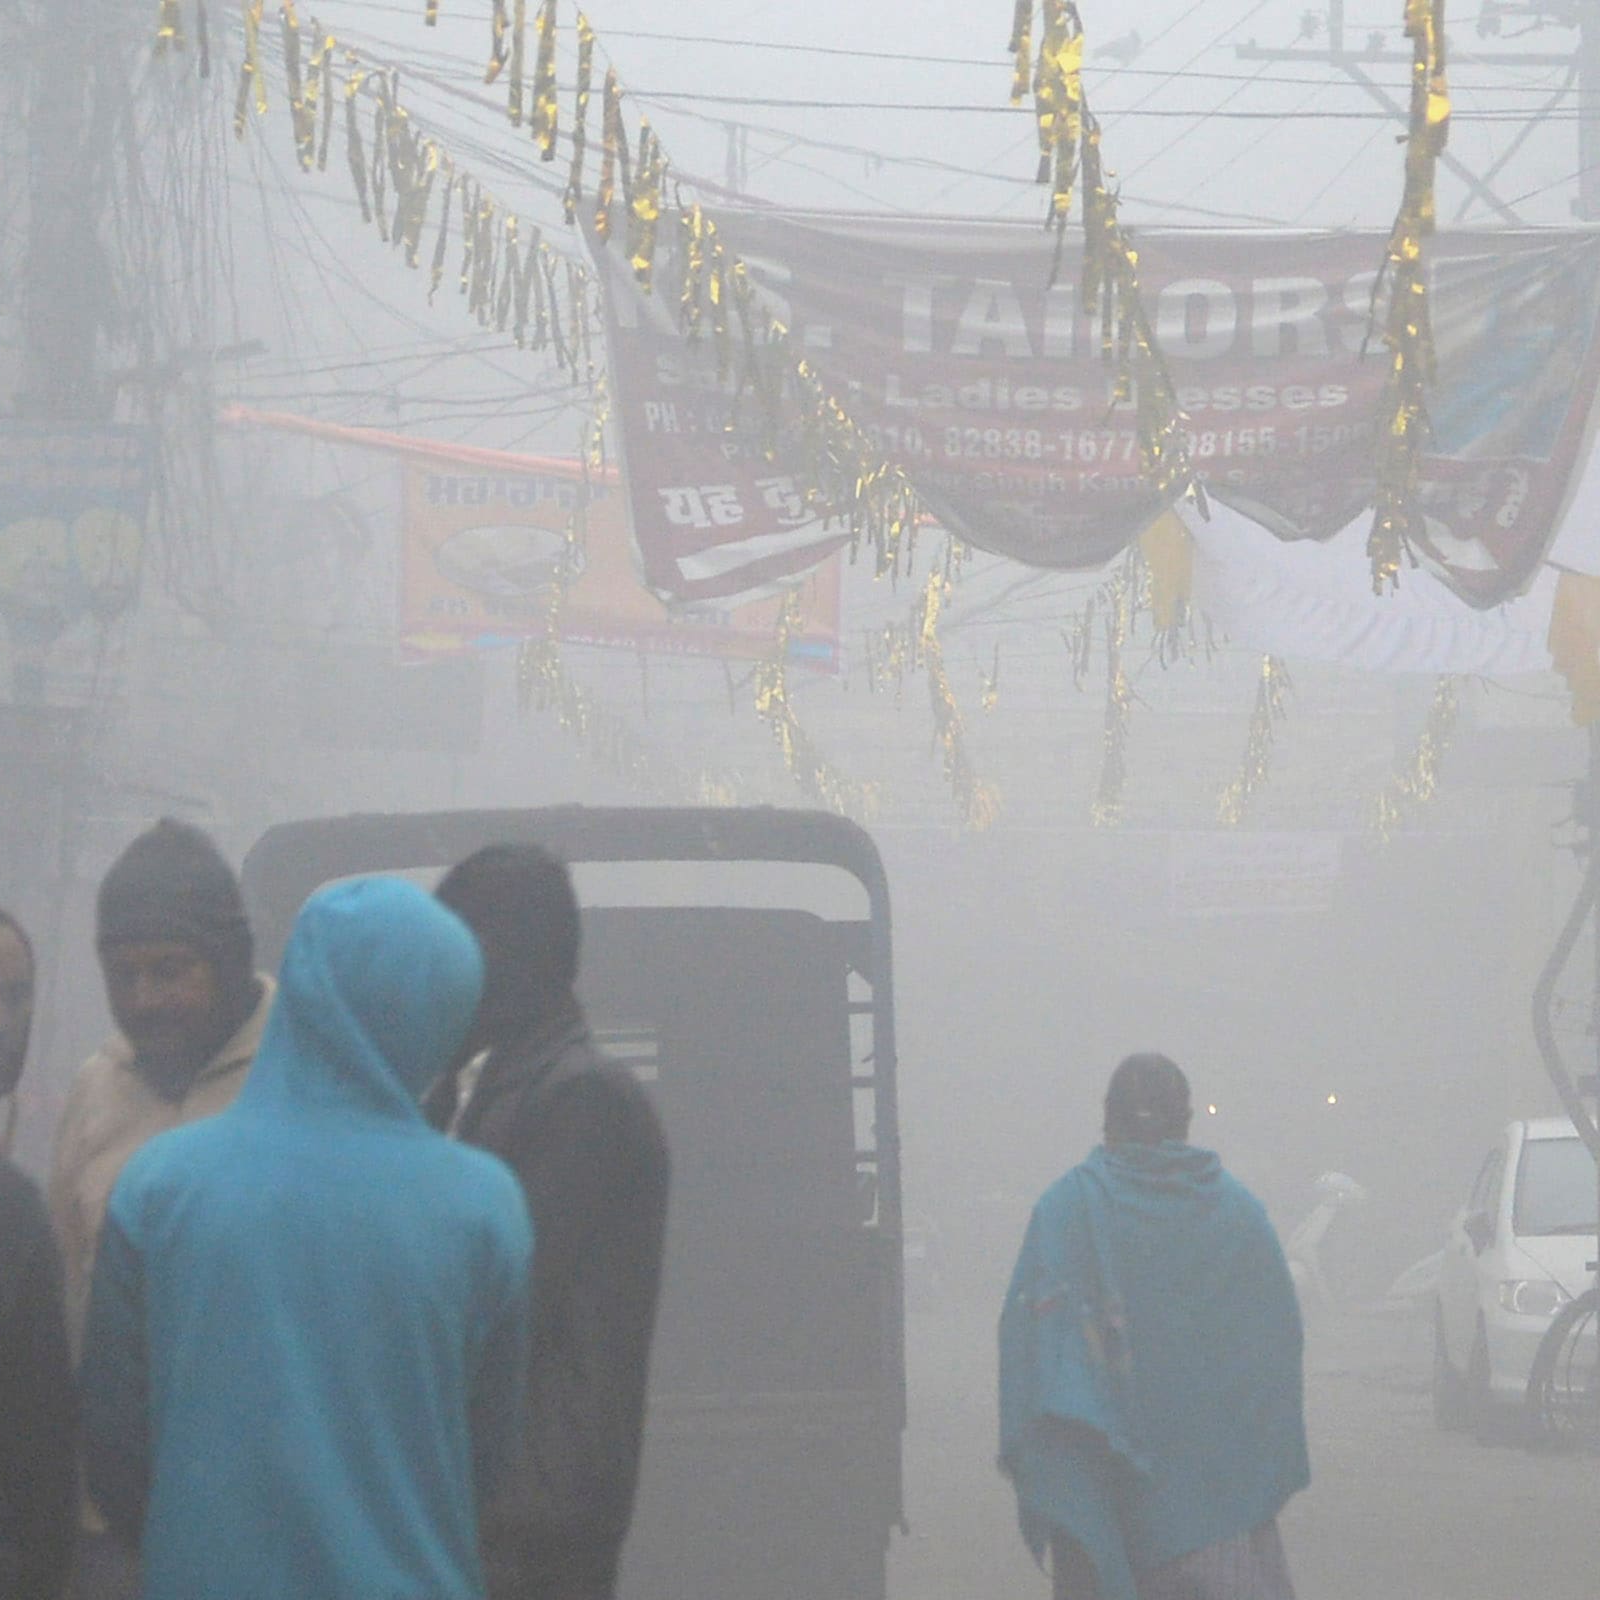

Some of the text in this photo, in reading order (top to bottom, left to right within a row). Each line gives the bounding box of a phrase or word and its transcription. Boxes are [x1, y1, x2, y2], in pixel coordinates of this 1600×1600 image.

[885, 375, 1083, 410] Ladies
[1107, 379, 1349, 411] Desses
[944, 425, 1142, 463] 82838-1677
